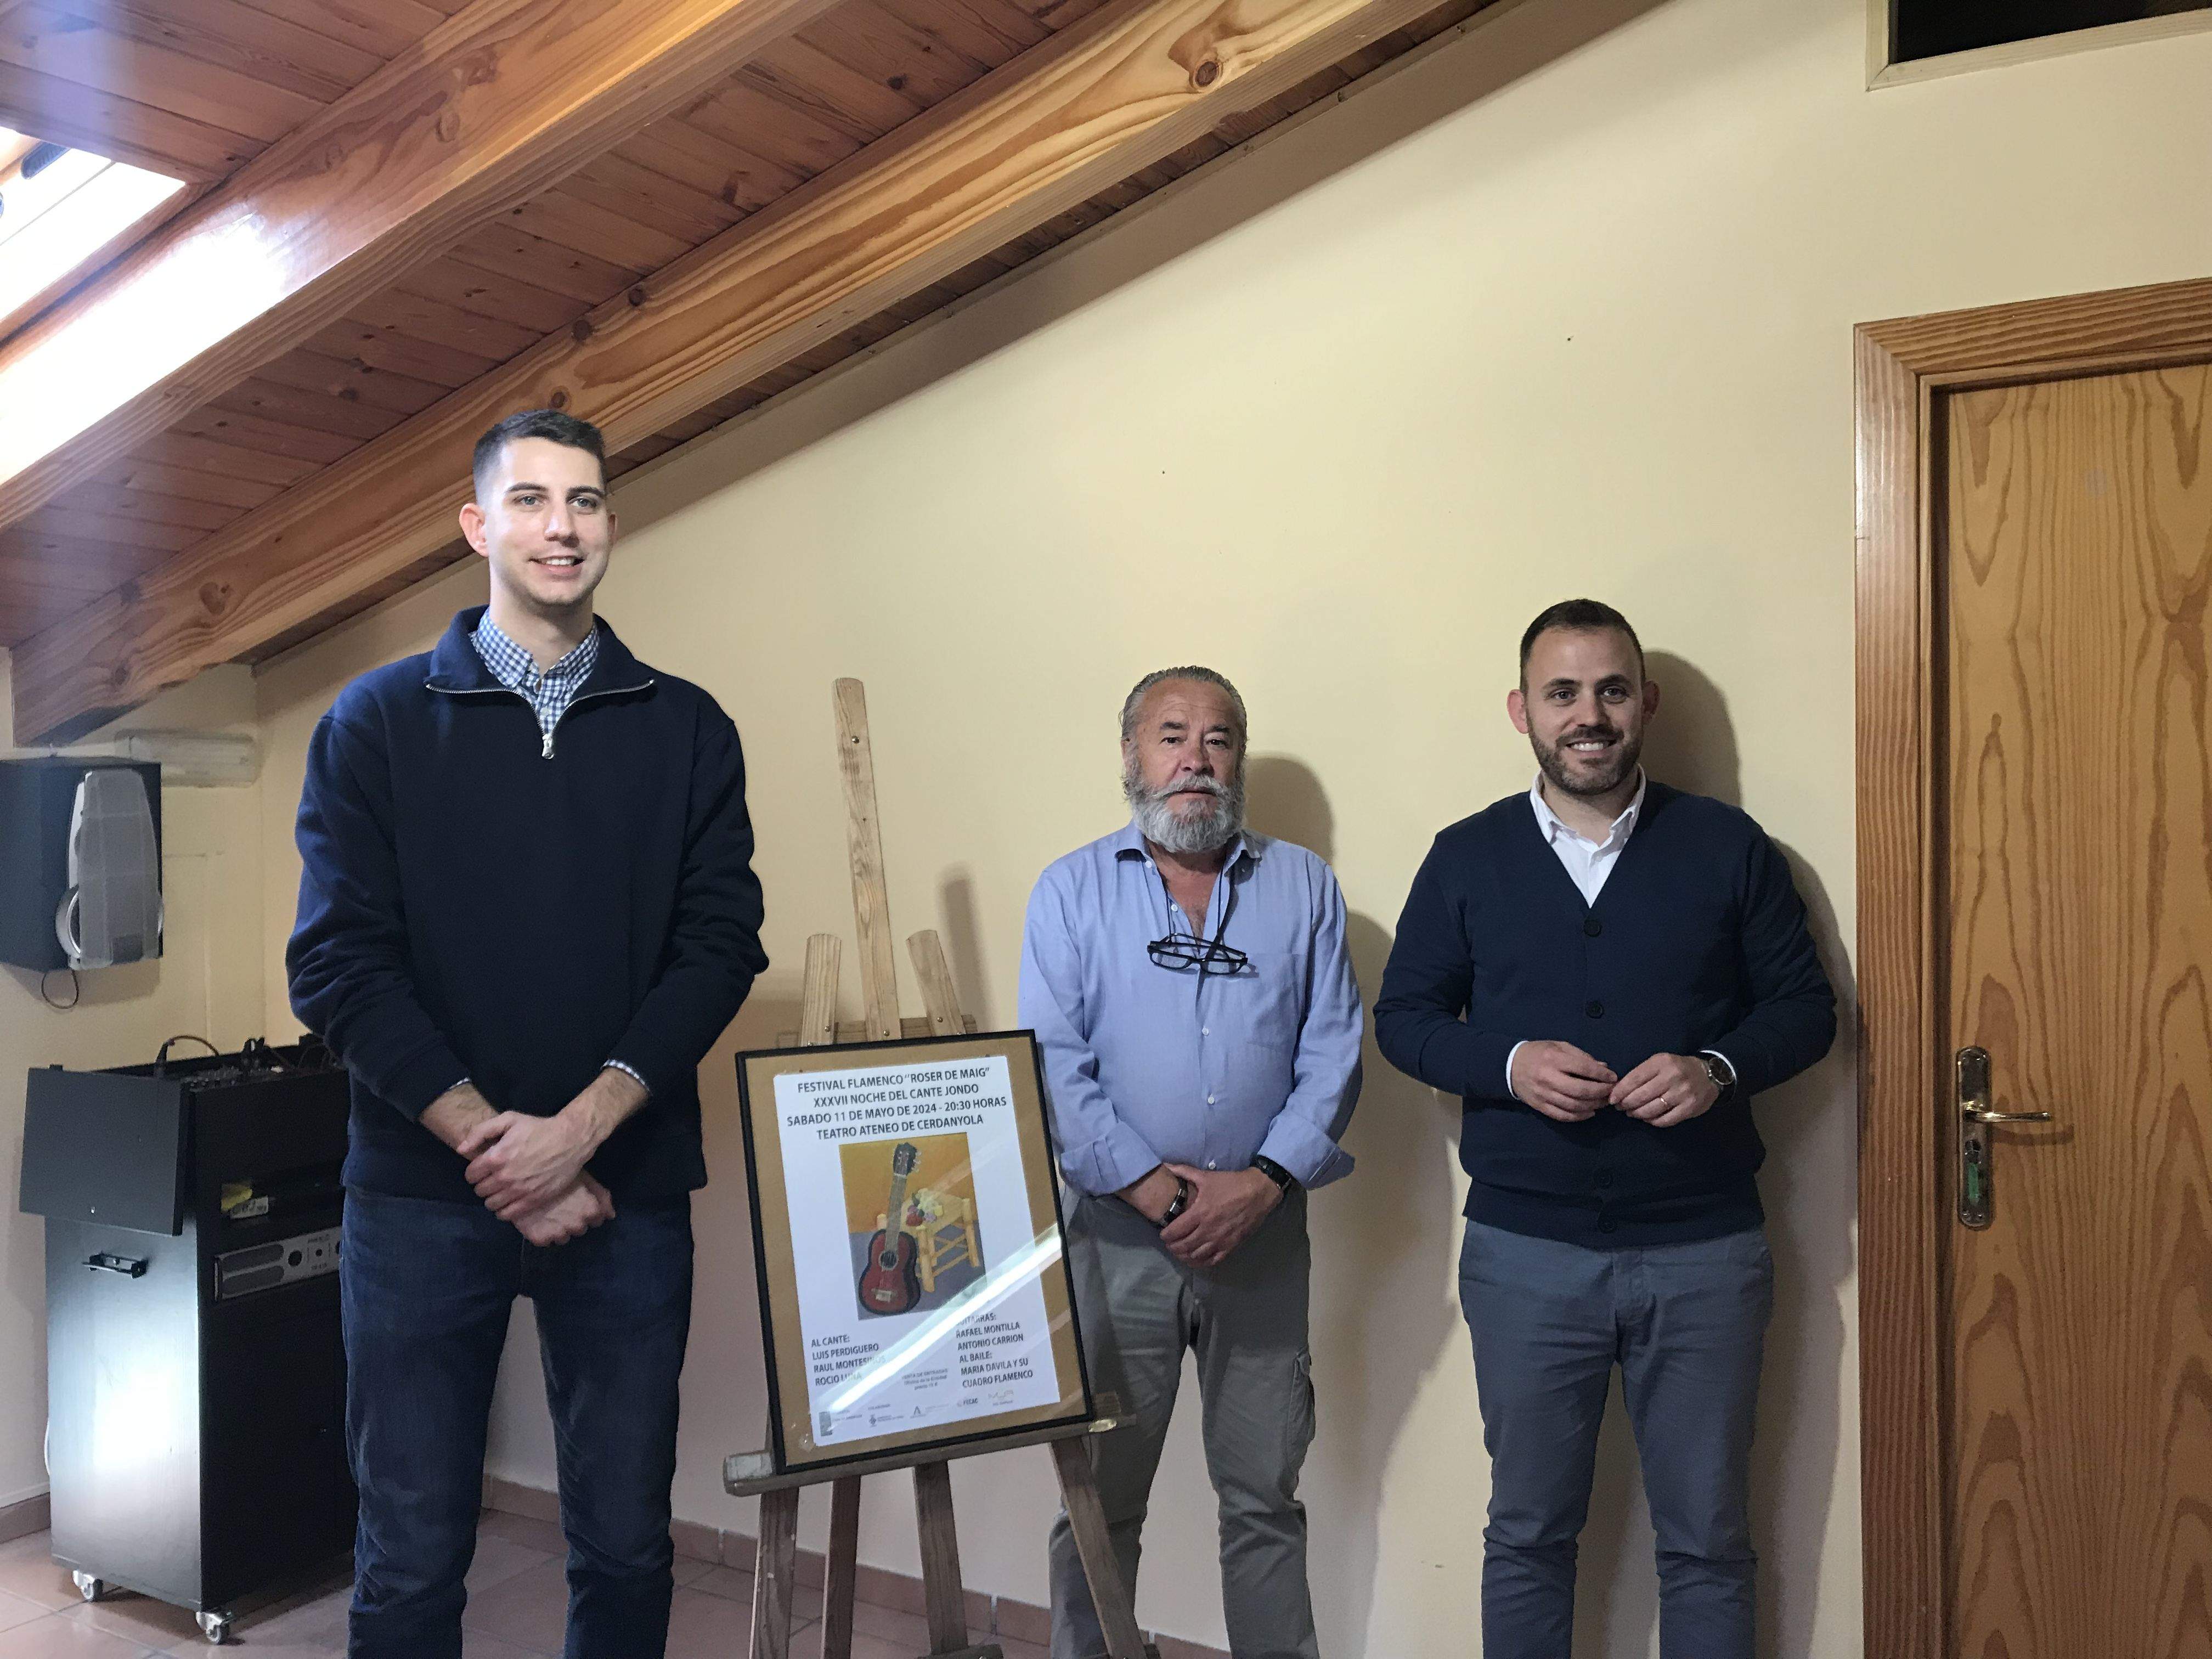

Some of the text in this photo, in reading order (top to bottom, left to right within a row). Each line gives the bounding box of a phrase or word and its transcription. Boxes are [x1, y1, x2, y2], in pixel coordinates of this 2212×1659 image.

[798, 1079, 845, 1093] FESTIVAL
[848, 1075, 903, 1089] FLAMENCO
[945, 1070, 958, 1080] DE
[814, 1084, 979, 1108] XXXVII NOCHE DEL CANTE JONDO
[787, 1113, 832, 1127] SABADO
[834, 1111, 845, 1122] 11
[849, 1109, 863, 1121] DE
[865, 1107, 895, 1119] MAYO
[897, 1105, 911, 1116] DE
[913, 1103, 936, 1115] 2024
[944, 1100, 971, 1111] 20:30
[973, 1097, 1007, 1109] HORAS
[816, 1114, 984, 1140] TEATRO ATENEO DE CERDANYOLA
[956, 1322, 1020, 1339] RAFAEL MONTILLA
[811, 1334, 850, 1347] AL CANTE:
[958, 1333, 1024, 1351] ANTONIO CARRION
[812, 1342, 879, 1361] LUIS PERDIGUERO
[960, 1351, 992, 1364] AL BAILE:
[814, 1363, 834, 1373] RAUL
[961, 1364, 984, 1376] MARIA
[985, 1360, 1012, 1372] DAVILA
[1019, 1357, 1029, 1367] SU
[815, 1375, 839, 1386] ROCIO
[962, 1369, 1033, 1389] CUADRO FLAMENCO
